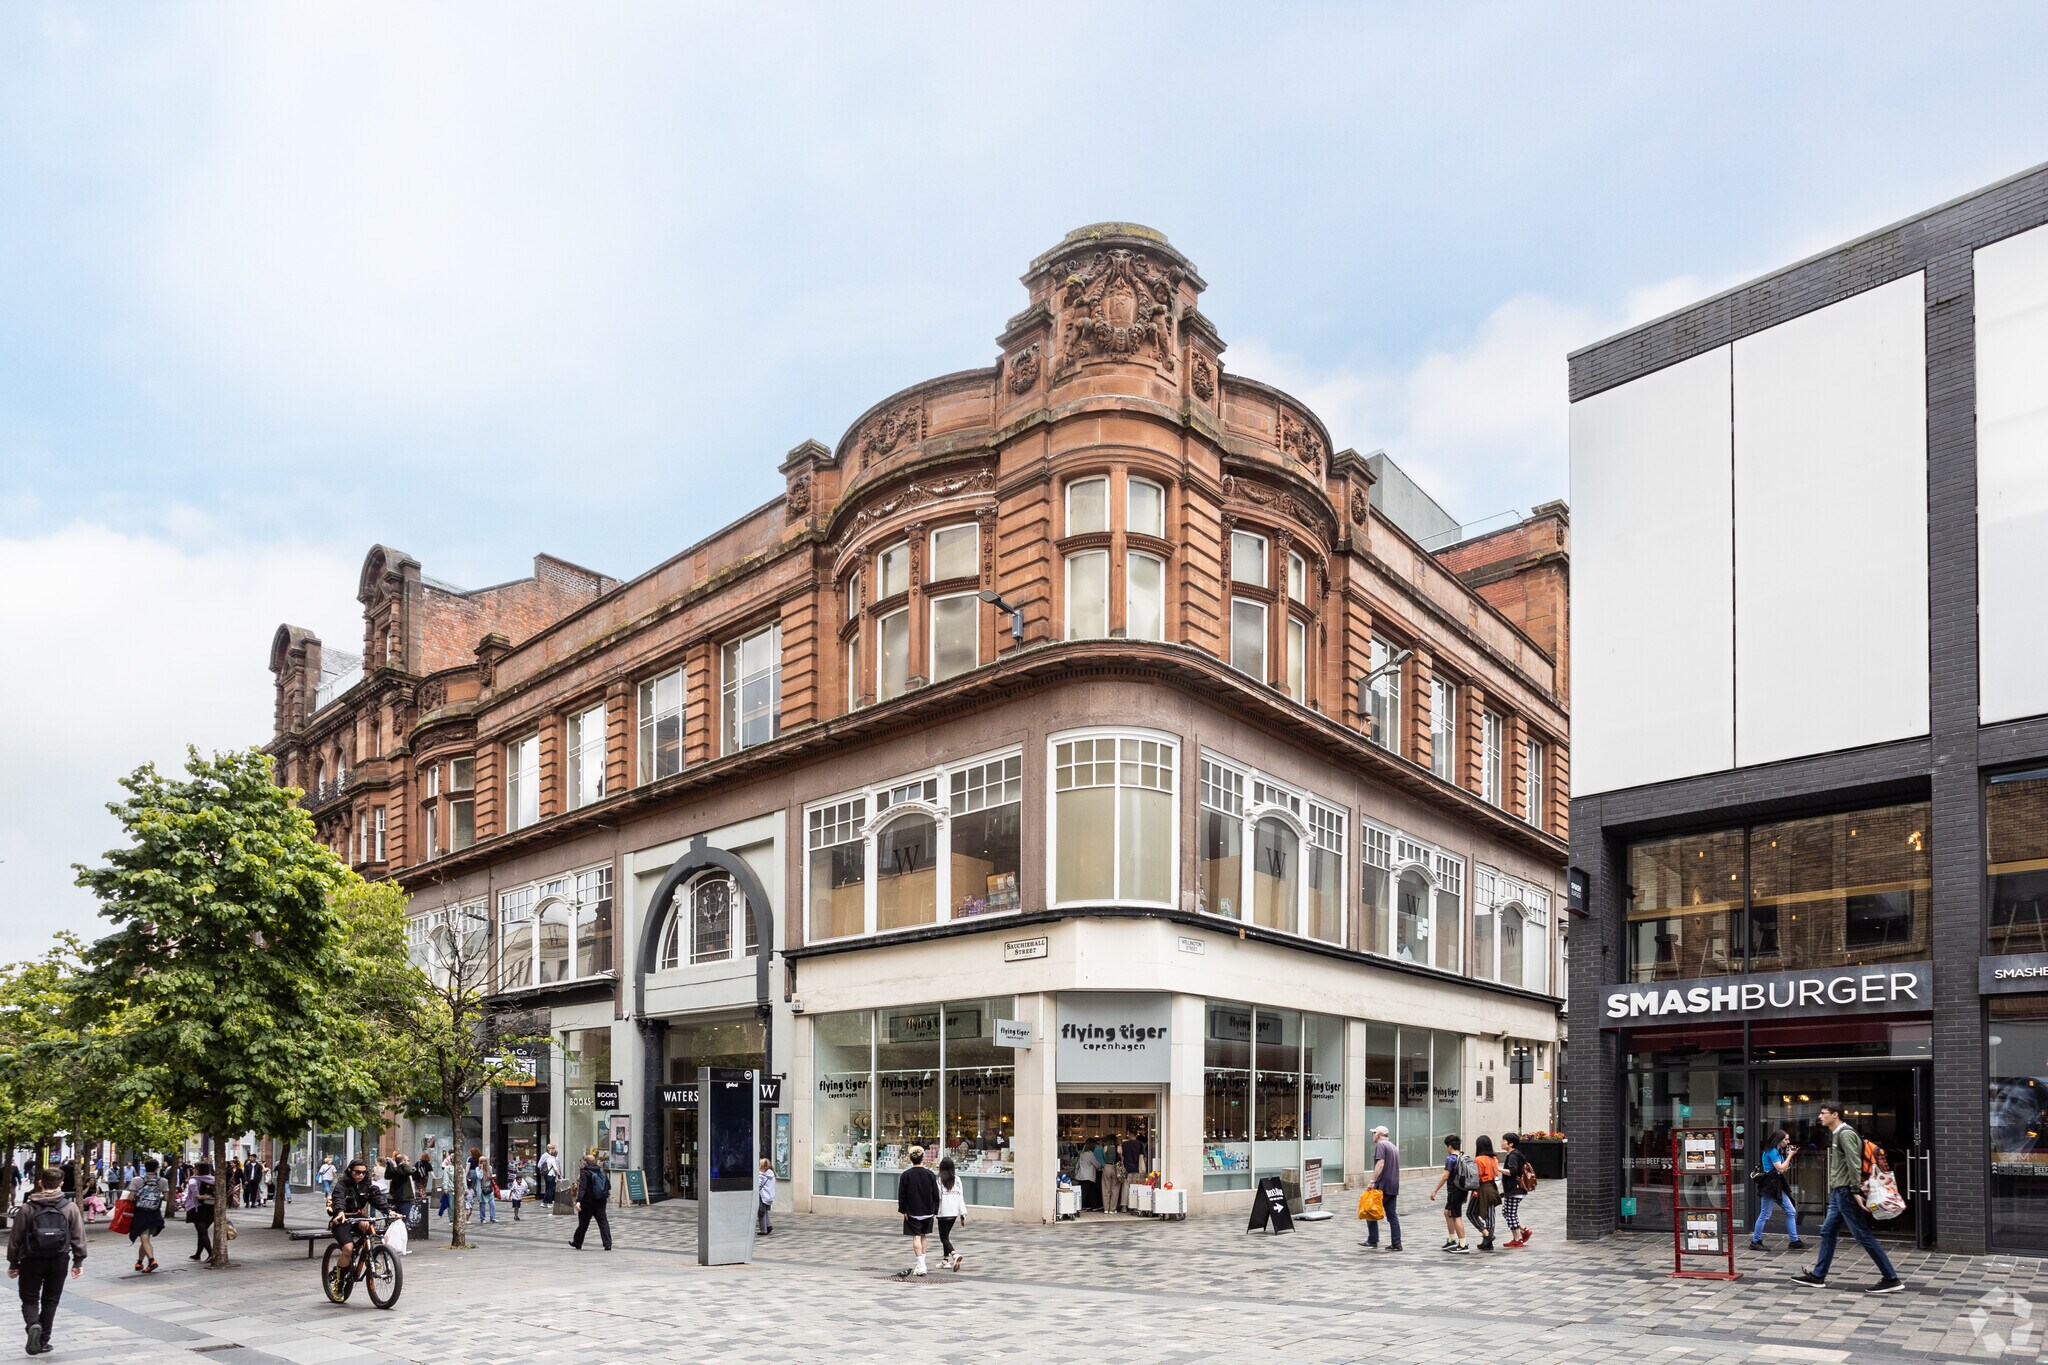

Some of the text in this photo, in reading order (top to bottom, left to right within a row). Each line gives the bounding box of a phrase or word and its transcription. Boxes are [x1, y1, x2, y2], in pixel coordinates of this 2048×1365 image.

[893, 844, 920, 876] W
[1265, 847, 1287, 878] W
[1405, 894, 1421, 918] W
[1181, 938, 1202, 948] WELLINGTON
[1506, 926, 1518, 948] W
[1006, 939, 1045, 950] SAUCHIEHALL
[1014, 947, 1037, 956] STREET
[1606, 972, 1918, 1018] SMASHBURGER
[906, 1017, 932, 1032] flying
[1230, 1016, 1251, 1031] flying
[1000, 1027, 1030, 1037] flying tiger
[1061, 1023, 1168, 1042] flying tiger
[1083, 1042, 1146, 1051] copenhagen
[819, 1079, 867, 1093] flying tiger
[881, 1077, 934, 1090] flying tiger
[952, 1075, 981, 1089] flying
[1325, 1081, 1341, 1093] tiger
[597, 1091, 617, 1099] BOOKS
[663, 1090, 699, 1102] WATERS
[760, 1084, 777, 1099] W
[1312, 1093, 1334, 1101] copenhagen
[1434, 1087, 1459, 1098] flying tiger
[600, 1099, 615, 1107] CAFÉ
[522, 1105, 528, 1114] ST
[1647, 1157, 1660, 1165] BEEF
